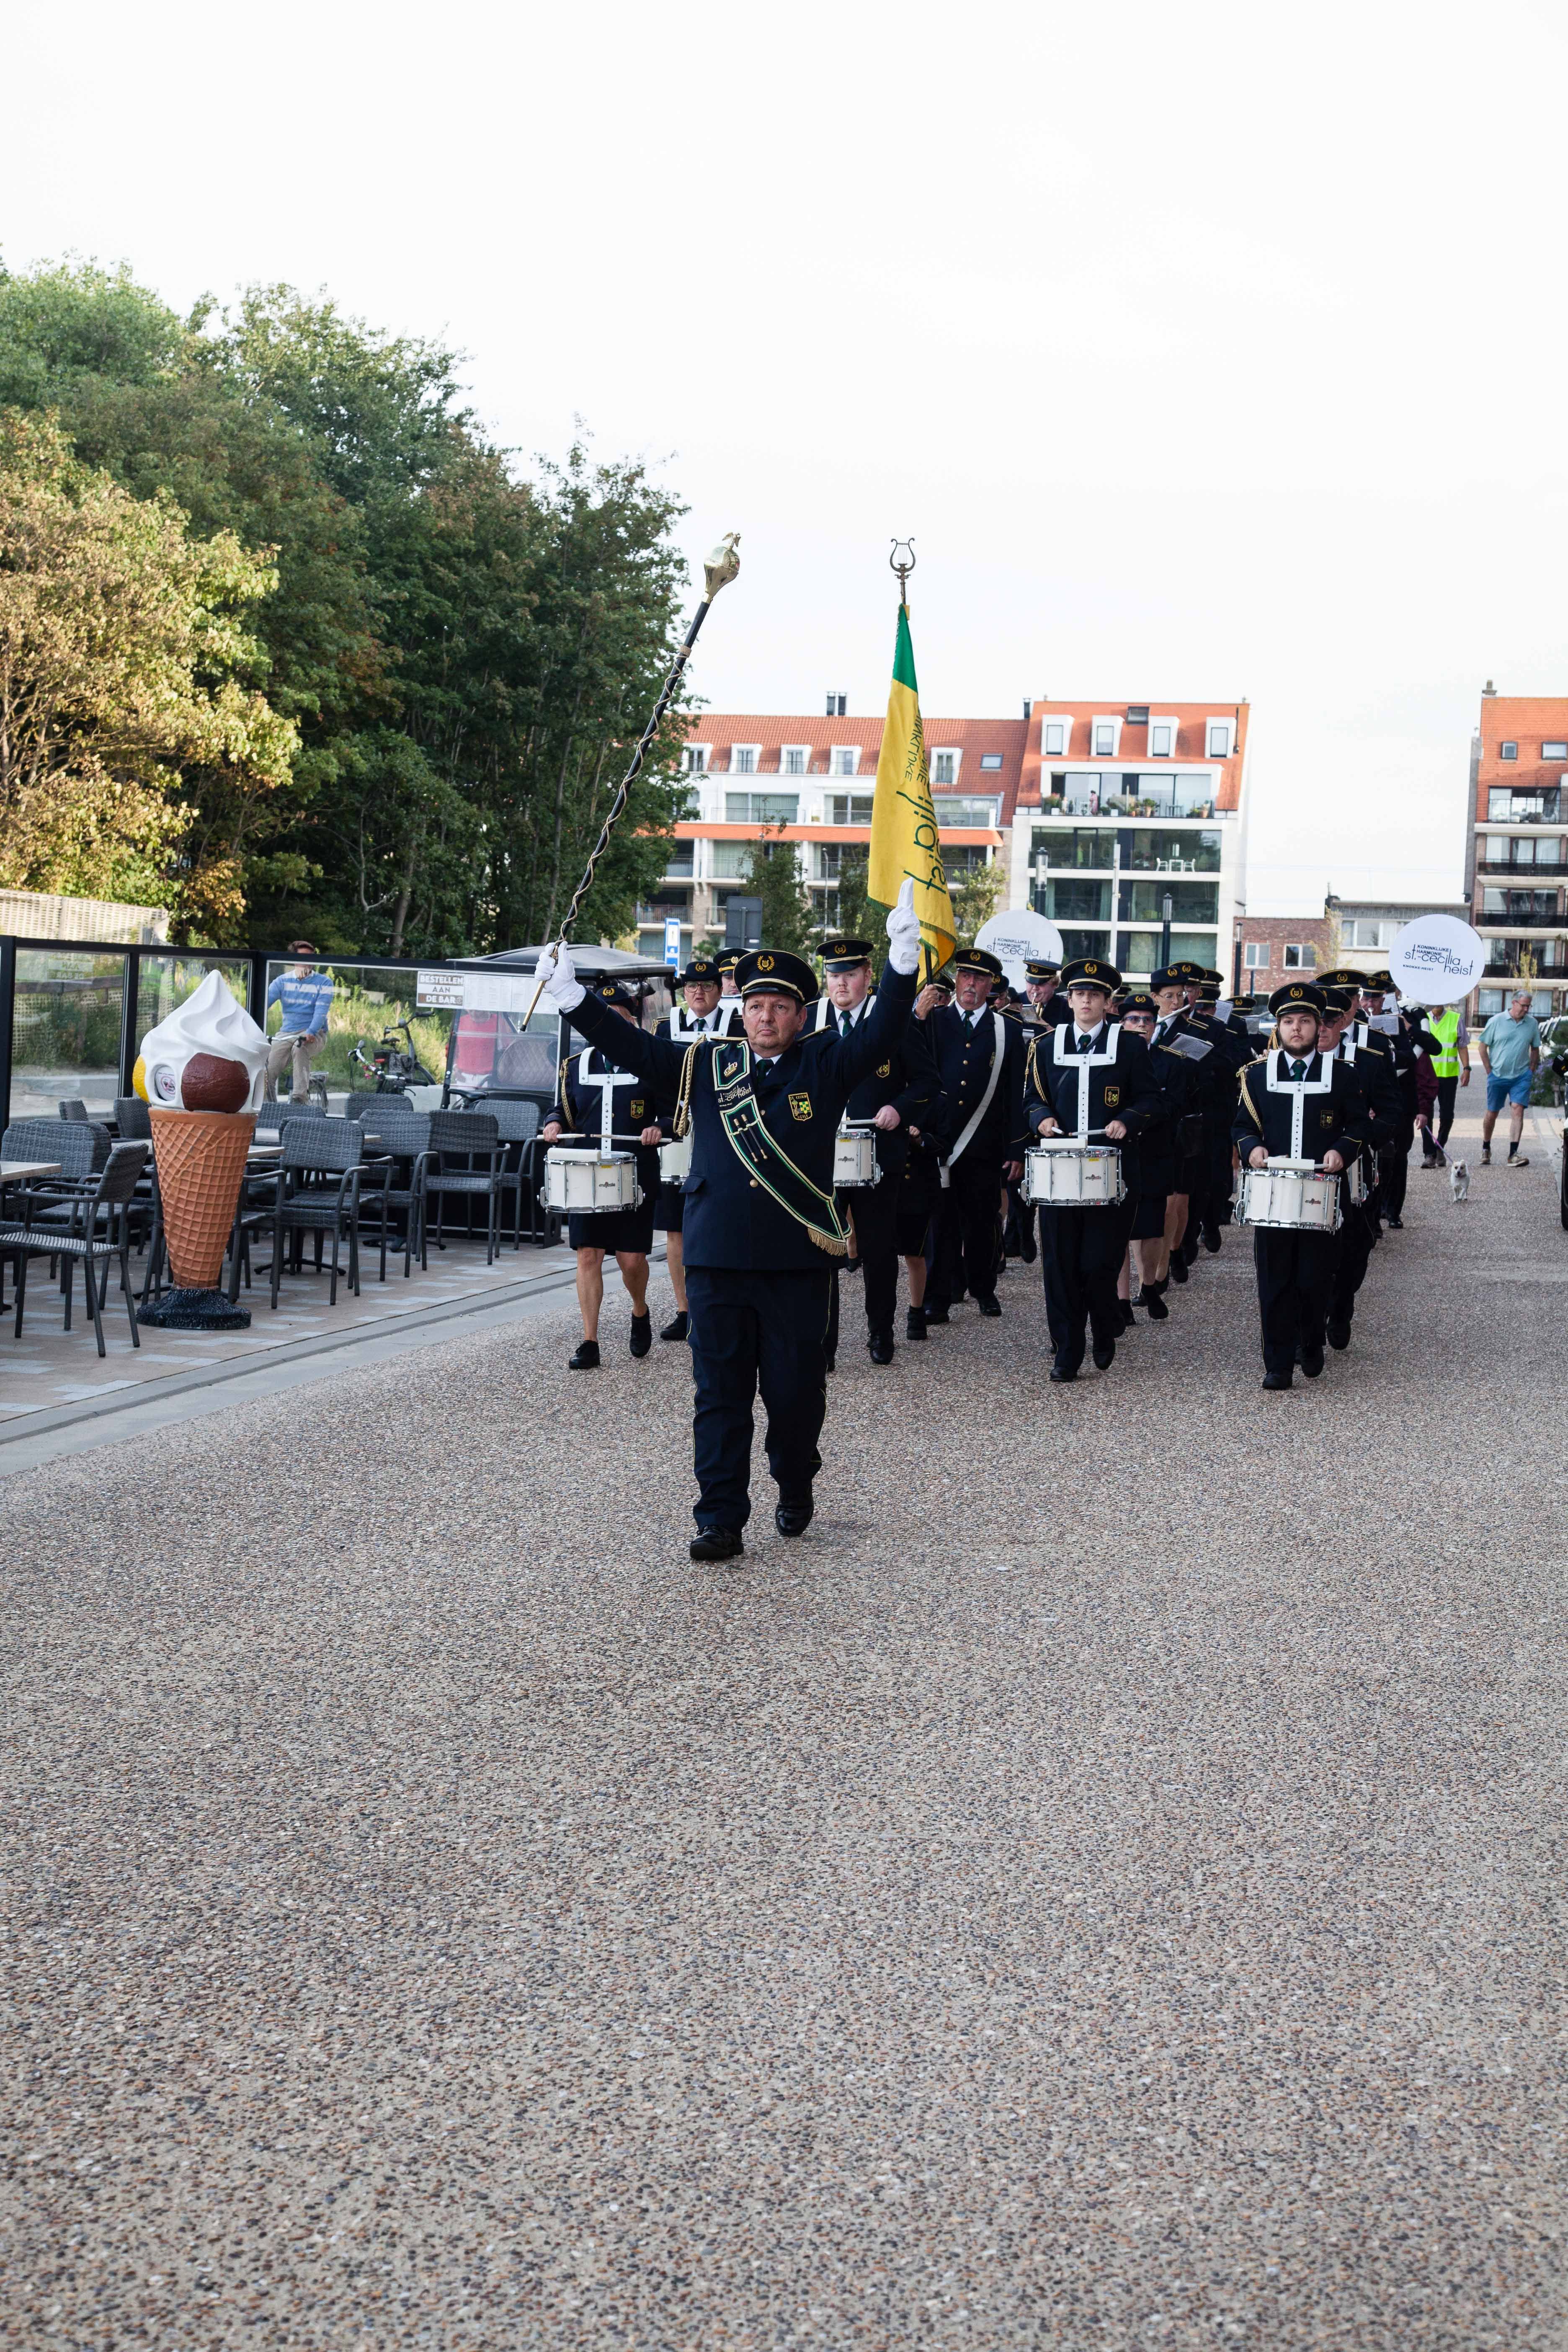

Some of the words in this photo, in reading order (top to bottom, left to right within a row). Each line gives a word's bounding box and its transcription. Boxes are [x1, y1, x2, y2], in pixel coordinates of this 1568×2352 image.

[1444, 959, 1473, 975] heist
[420, 975, 463, 985] BESTELLEN
[438, 995, 456, 1004] BAR
